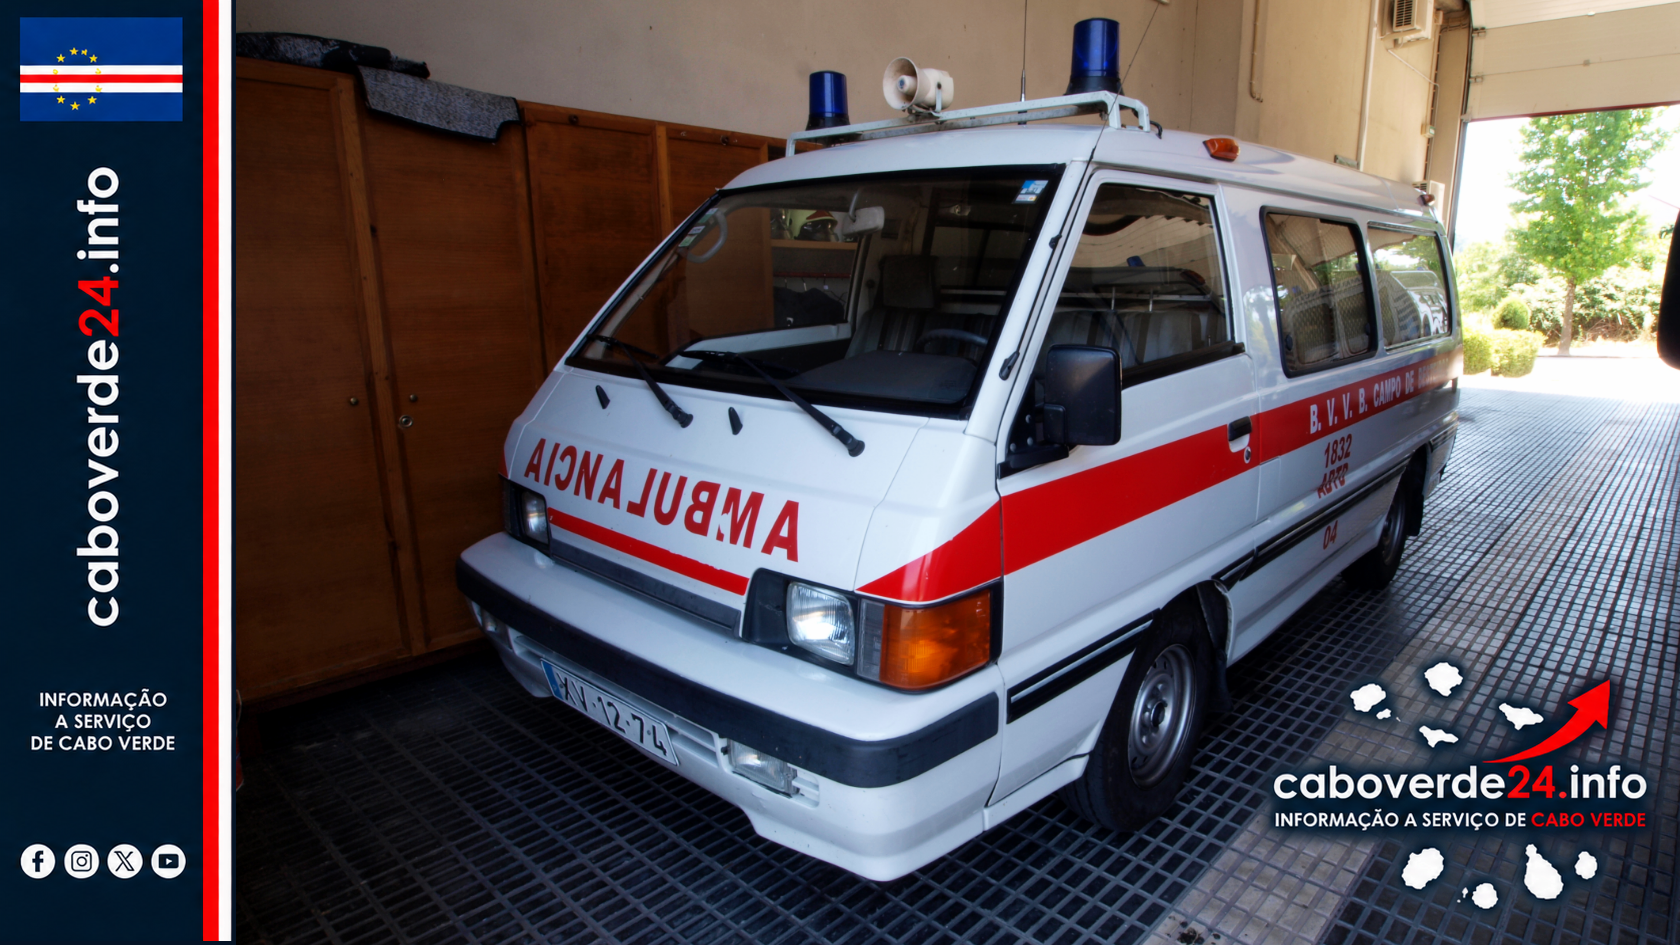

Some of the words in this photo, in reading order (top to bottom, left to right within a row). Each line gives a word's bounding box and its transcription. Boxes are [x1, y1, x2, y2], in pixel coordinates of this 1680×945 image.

[1310, 404, 1322, 434] B.
[1327, 397, 1338, 426] V.
[1342, 392, 1353, 420] V.
[1359, 387, 1368, 414] B.
[1373, 375, 1402, 408] CAMPO
[1405, 370, 1415, 395] DE
[1324, 433, 1352, 468] 1832
[1322, 520, 1339, 550] 04
